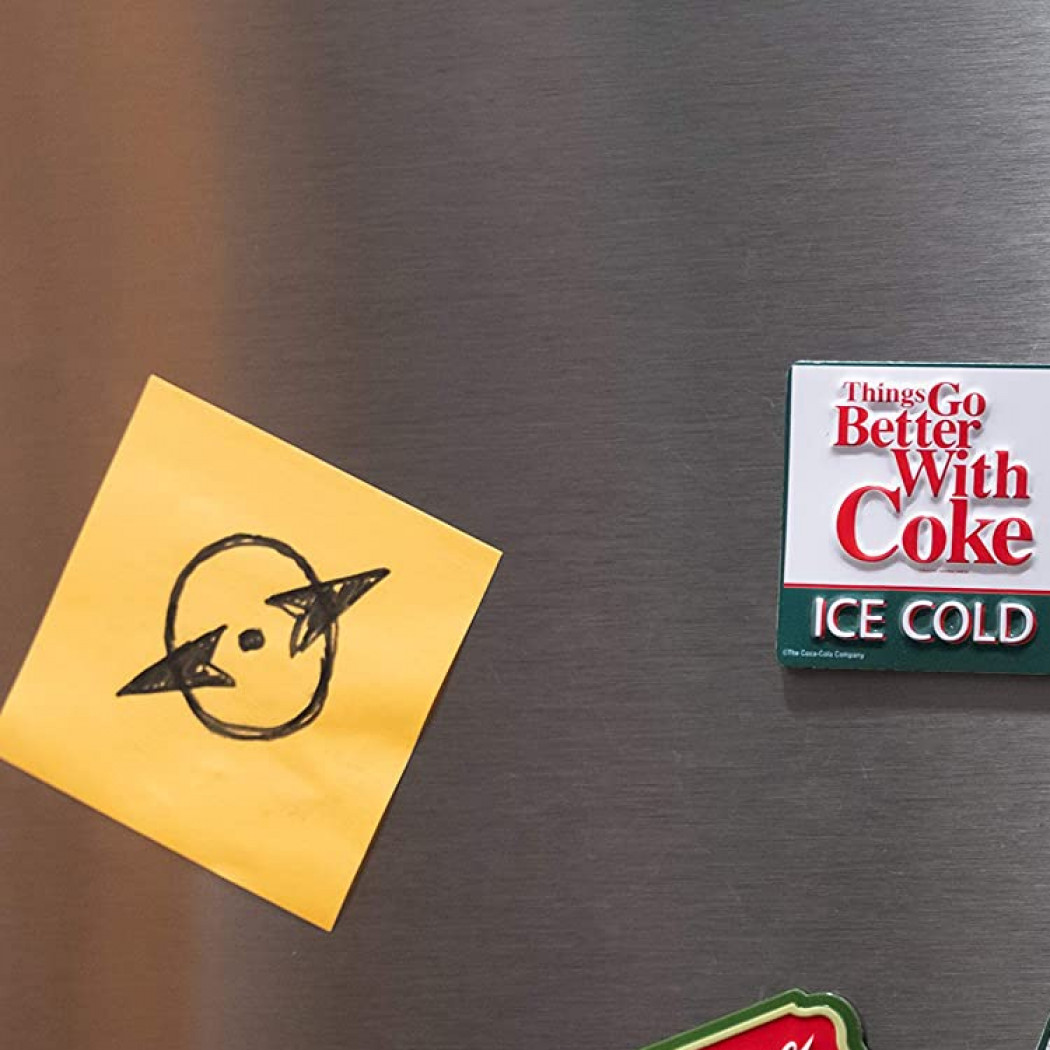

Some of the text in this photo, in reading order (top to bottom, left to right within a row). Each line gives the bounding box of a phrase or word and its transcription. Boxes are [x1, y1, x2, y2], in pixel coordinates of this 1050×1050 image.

[843, 381, 987, 417] Things Go
[833, 405, 983, 449] Better
[890, 448, 1031, 499] With
[836, 485, 1034, 566] Coke
[815, 597, 1038, 645] ICE COLD
